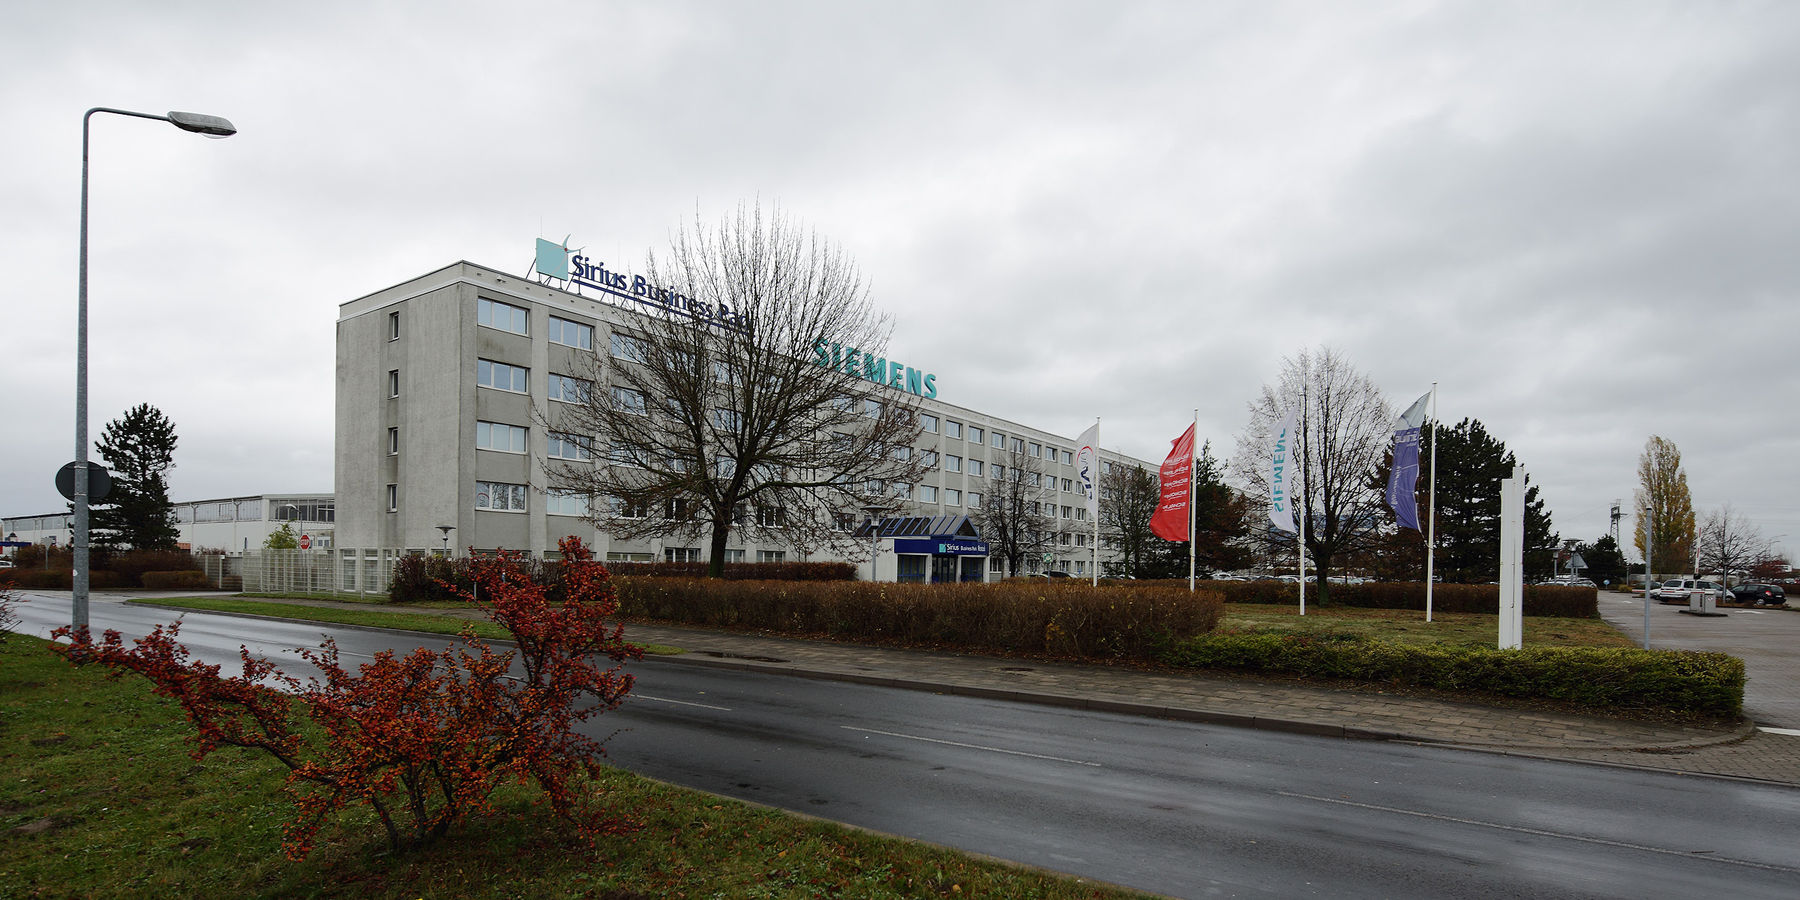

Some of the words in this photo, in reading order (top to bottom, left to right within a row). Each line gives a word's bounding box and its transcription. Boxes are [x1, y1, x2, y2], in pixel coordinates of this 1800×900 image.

[571, 254, 627, 291] Sirius
[633, 274, 714, 318] Business
[812, 337, 937, 399] SIEMENS
